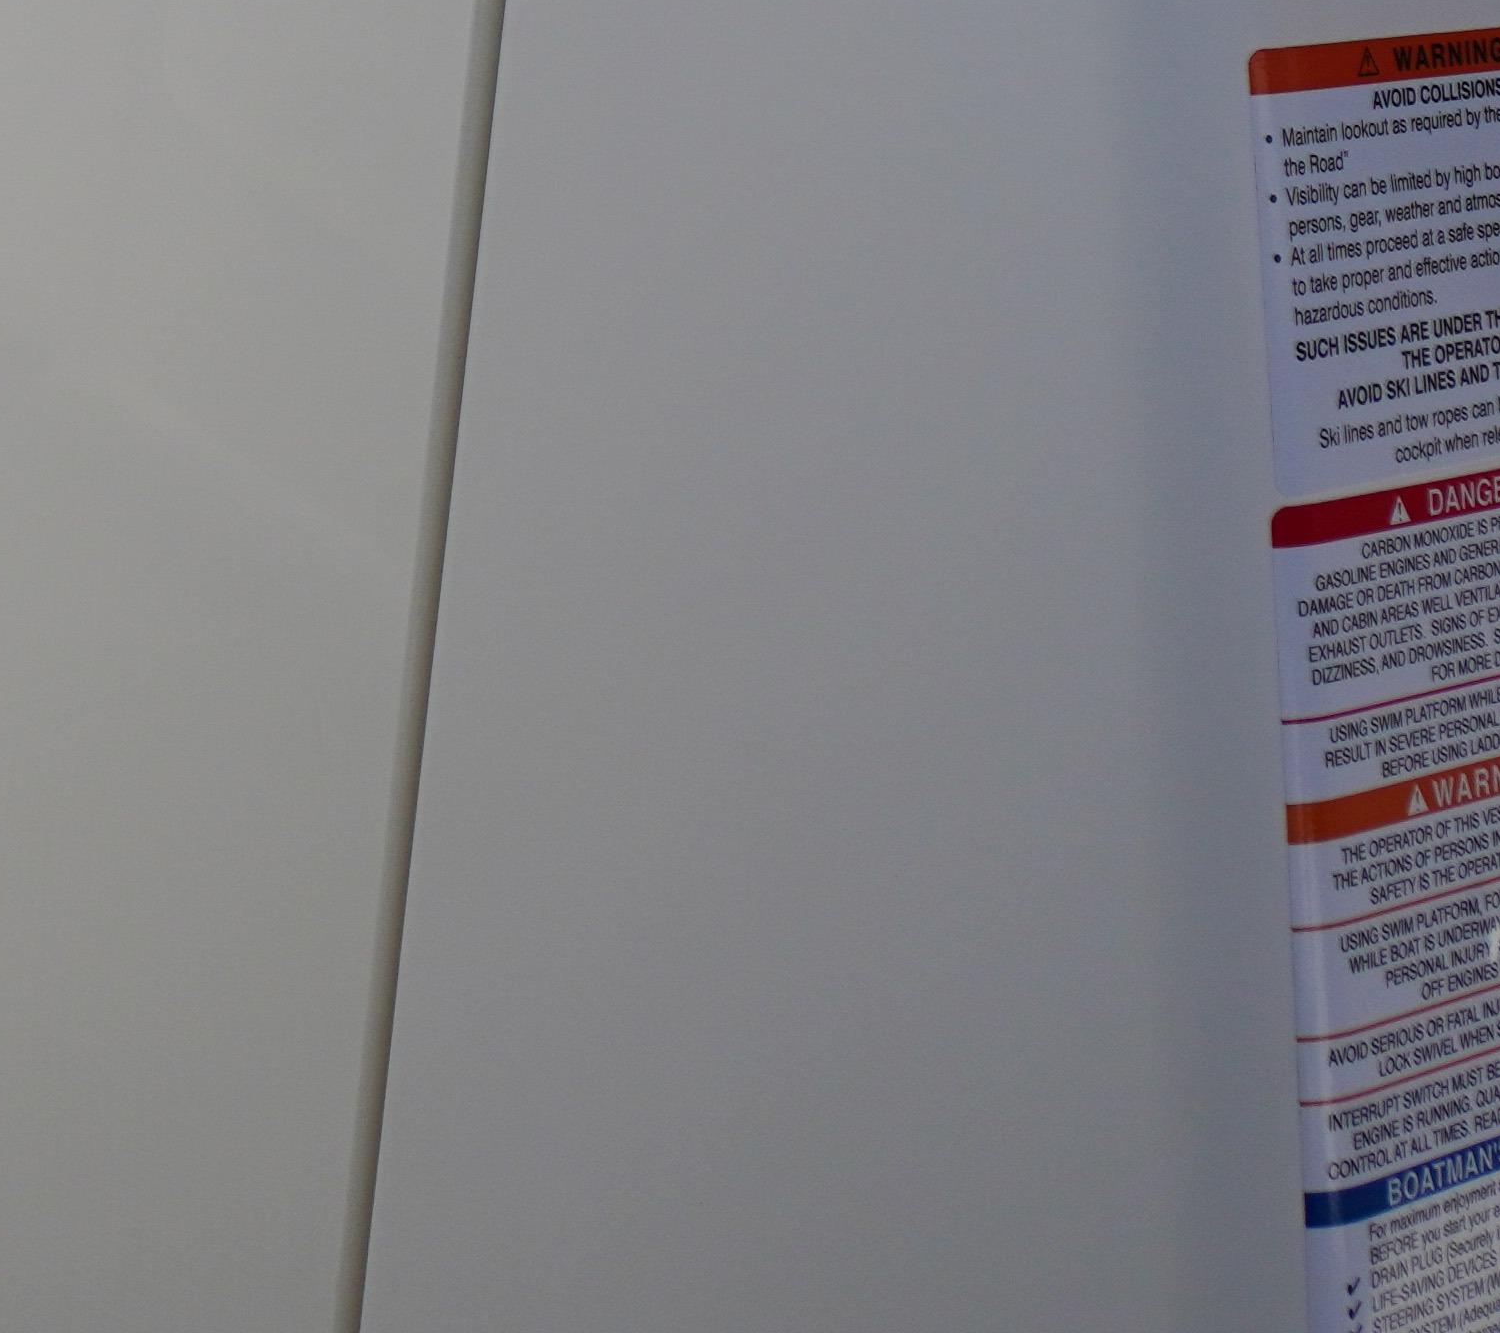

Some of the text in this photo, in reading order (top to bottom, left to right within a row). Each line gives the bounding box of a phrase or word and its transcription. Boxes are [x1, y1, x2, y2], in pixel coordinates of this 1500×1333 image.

[1373, 87, 1416, 109] AVOID
[1282, 123, 1338, 147] Maintain
[1341, 118, 1389, 140] lookout
[1392, 119, 1407, 135] as
[1411, 109, 1463, 133] required
[1465, 108, 1481, 129] by
[1283, 157, 1306, 177] the
[1285, 183, 1339, 206] Visibility
[1343, 182, 1367, 199] can
[1370, 177, 1387, 195] be
[1390, 170, 1432, 192] limited
[1435, 169, 1450, 191] by
[1454, 164, 1481, 188] high
[1385, 201, 1434, 222] weather
[1438, 195, 1462, 216] and
[1291, 247, 1306, 266] At
[1309, 243, 1324, 264] all
[1327, 242, 1362, 261] times
[1366, 230, 1418, 259] proceed
[1422, 229, 1434, 247] at
[1437, 230, 1446, 245] a
[1448, 222, 1474, 243] safe
[1292, 278, 1306, 296] to
[1310, 274, 1338, 293] take
[1342, 269, 1384, 293] proper
[1388, 260, 1412, 281] and
[1415, 254, 1467, 277] effective
[1294, 301, 1364, 326] hazardous
[1296, 337, 1339, 362] SUCH
[1344, 326, 1396, 353] ISSUES
[1400, 321, 1430, 344] ARE
[1433, 312, 1483, 338] UNDER
[1401, 347, 1431, 369] THE
[1338, 383, 1382, 409] AVOID
[1386, 377, 1410, 400] SKI
[1414, 369, 1456, 395] LINES
[1460, 364, 1490, 386] AND
[1319, 427, 1340, 449] Ski
[1344, 424, 1374, 444] lines
[1378, 415, 1402, 437] and
[1405, 414, 1428, 431] tow
[1432, 406, 1468, 428] ropes
[1472, 401, 1494, 419] can
[1395, 437, 1442, 463] cockpit
[1444, 433, 1479, 453] when
[1361, 535, 1411, 559] CARBON
[1413, 521, 1475, 549] MONOXIDE
[1477, 518, 1488, 535] IS
[1315, 564, 1376, 591] GASOLINE
[1379, 553, 1430, 579] ENGINES
[1433, 548, 1457, 567] AND
[1297, 592, 1354, 617] DAMAGE
[1356, 588, 1374, 607] OR
[1377, 579, 1415, 602] DEATH
[1417, 571, 1452, 593] FROM
[1308, 635, 1367, 663] EXHAUST
[1431, 613, 1466, 637] SIGNS
[1469, 609, 1484, 627] OF
[1313, 619, 1339, 638] AND
[1342, 611, 1378, 633] CABIN
[1381, 601, 1419, 624] AREAS
[1421, 595, 1454, 615] WELL
[1382, 651, 1406, 670] AND
[1431, 662, 1456, 681] FOR
[1458, 653, 1492, 675] MORE
